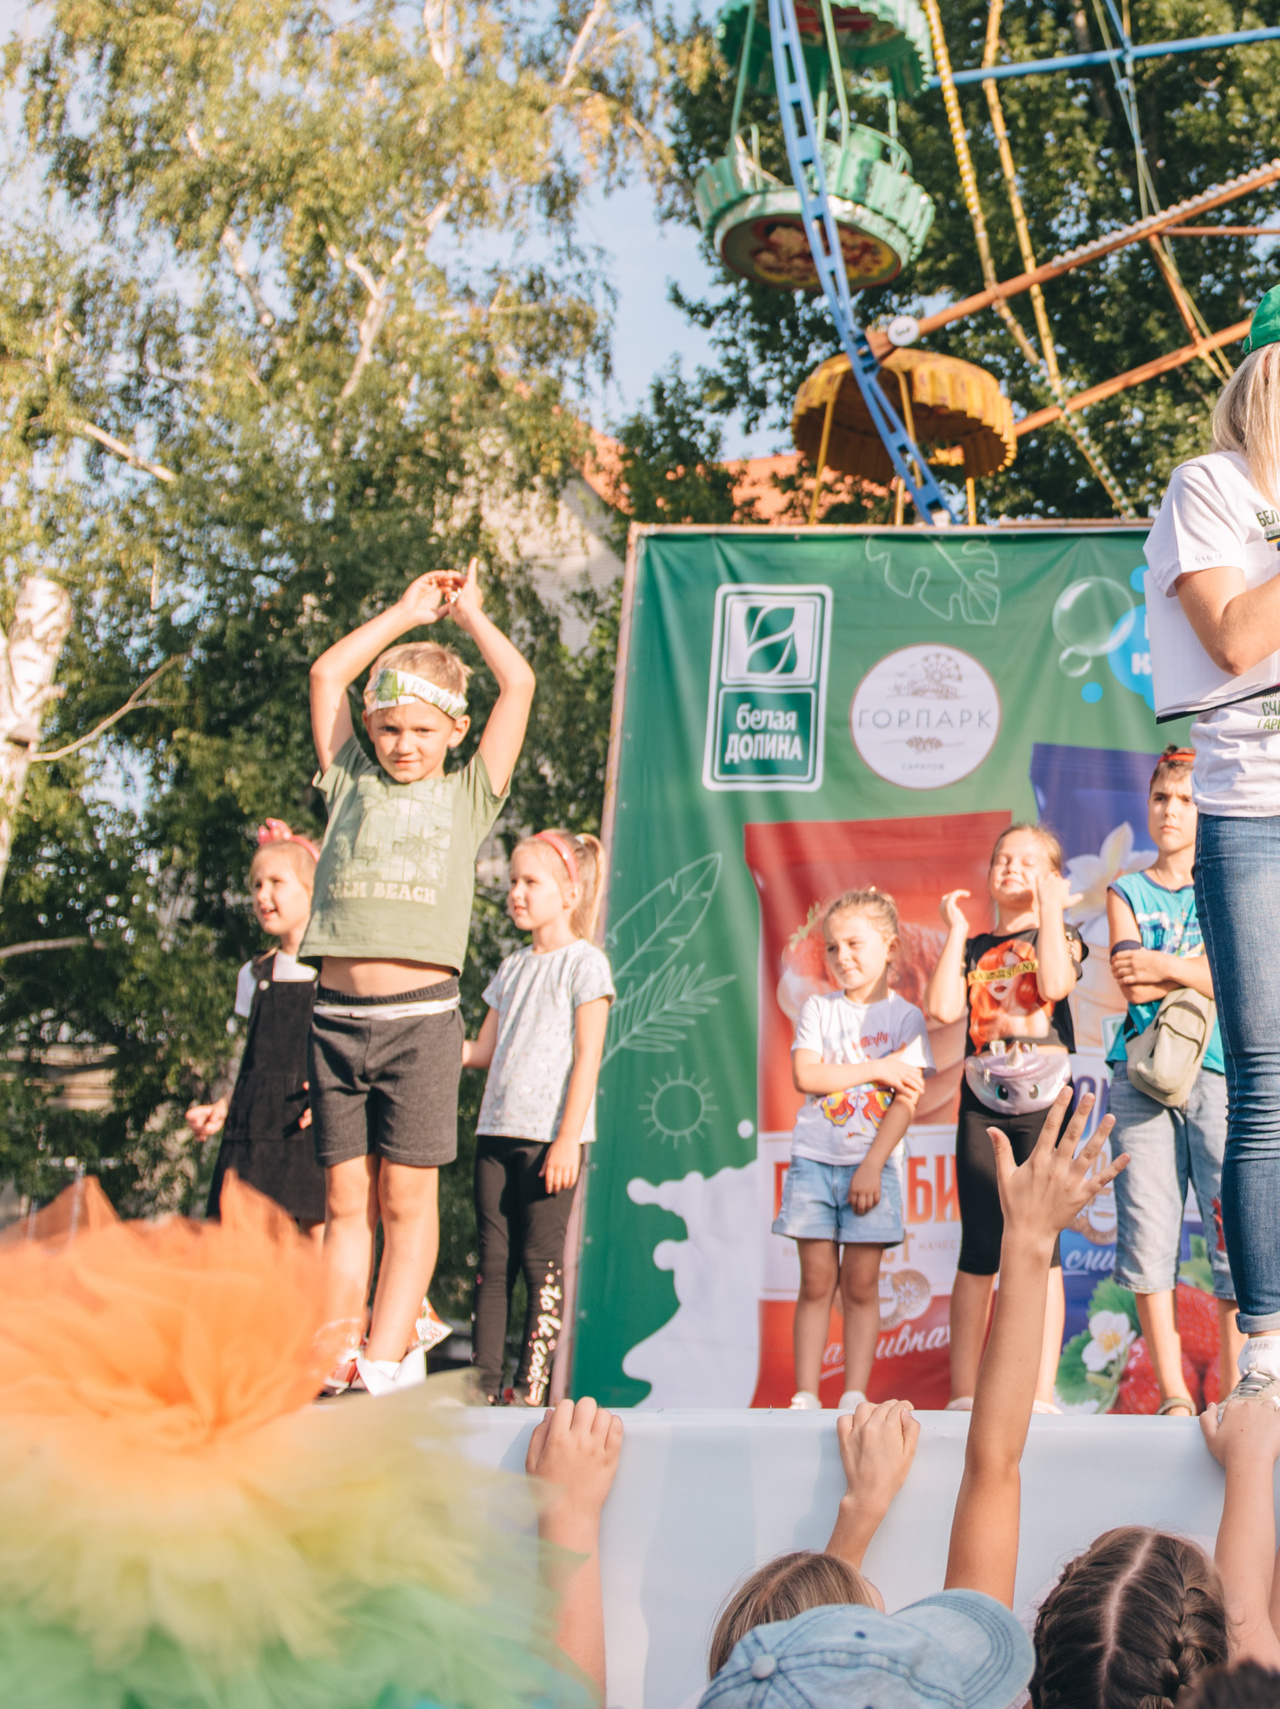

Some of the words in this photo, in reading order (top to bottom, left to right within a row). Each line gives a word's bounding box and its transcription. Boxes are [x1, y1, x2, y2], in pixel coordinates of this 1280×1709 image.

[735, 702, 797, 732] белая
[858, 707, 993, 730] ГОРПАРК
[724, 732, 804, 765] ДОЛИНА
[901, 762, 945, 772] САРАТОВ
[327, 881, 368, 900] PALM
[372, 881, 437, 906] BEACH
